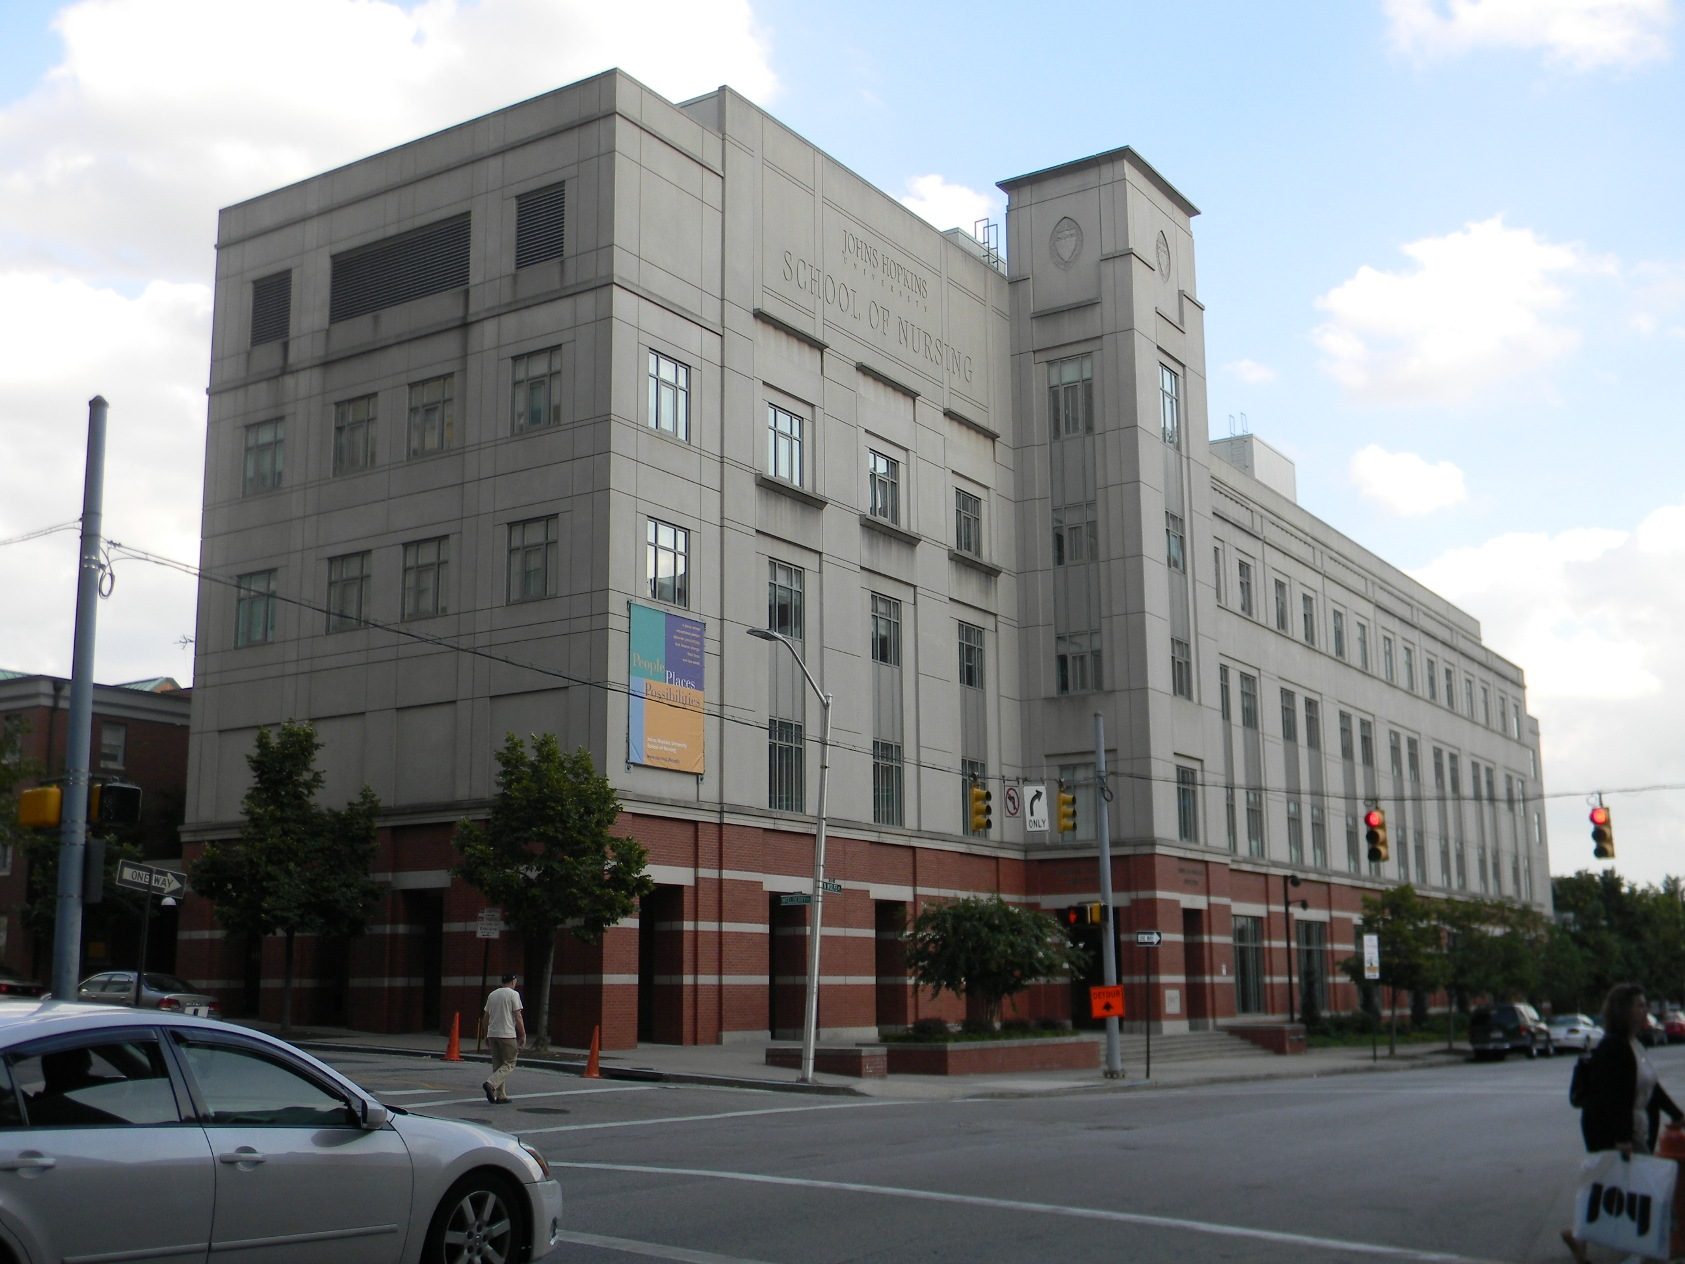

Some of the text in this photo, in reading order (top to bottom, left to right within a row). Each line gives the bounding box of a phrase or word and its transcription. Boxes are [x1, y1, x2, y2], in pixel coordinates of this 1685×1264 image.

[842, 229, 928, 299] JOHNS HOPKINS
[782, 250, 974, 383] SCHOOL OF NURSING
[632, 652, 666, 676] People
[666, 670, 697, 689] Places
[645, 681, 701, 707] Possibilities
[1028, 819, 1047, 829] ONLY
[131, 870, 174, 888] ONE WAY
